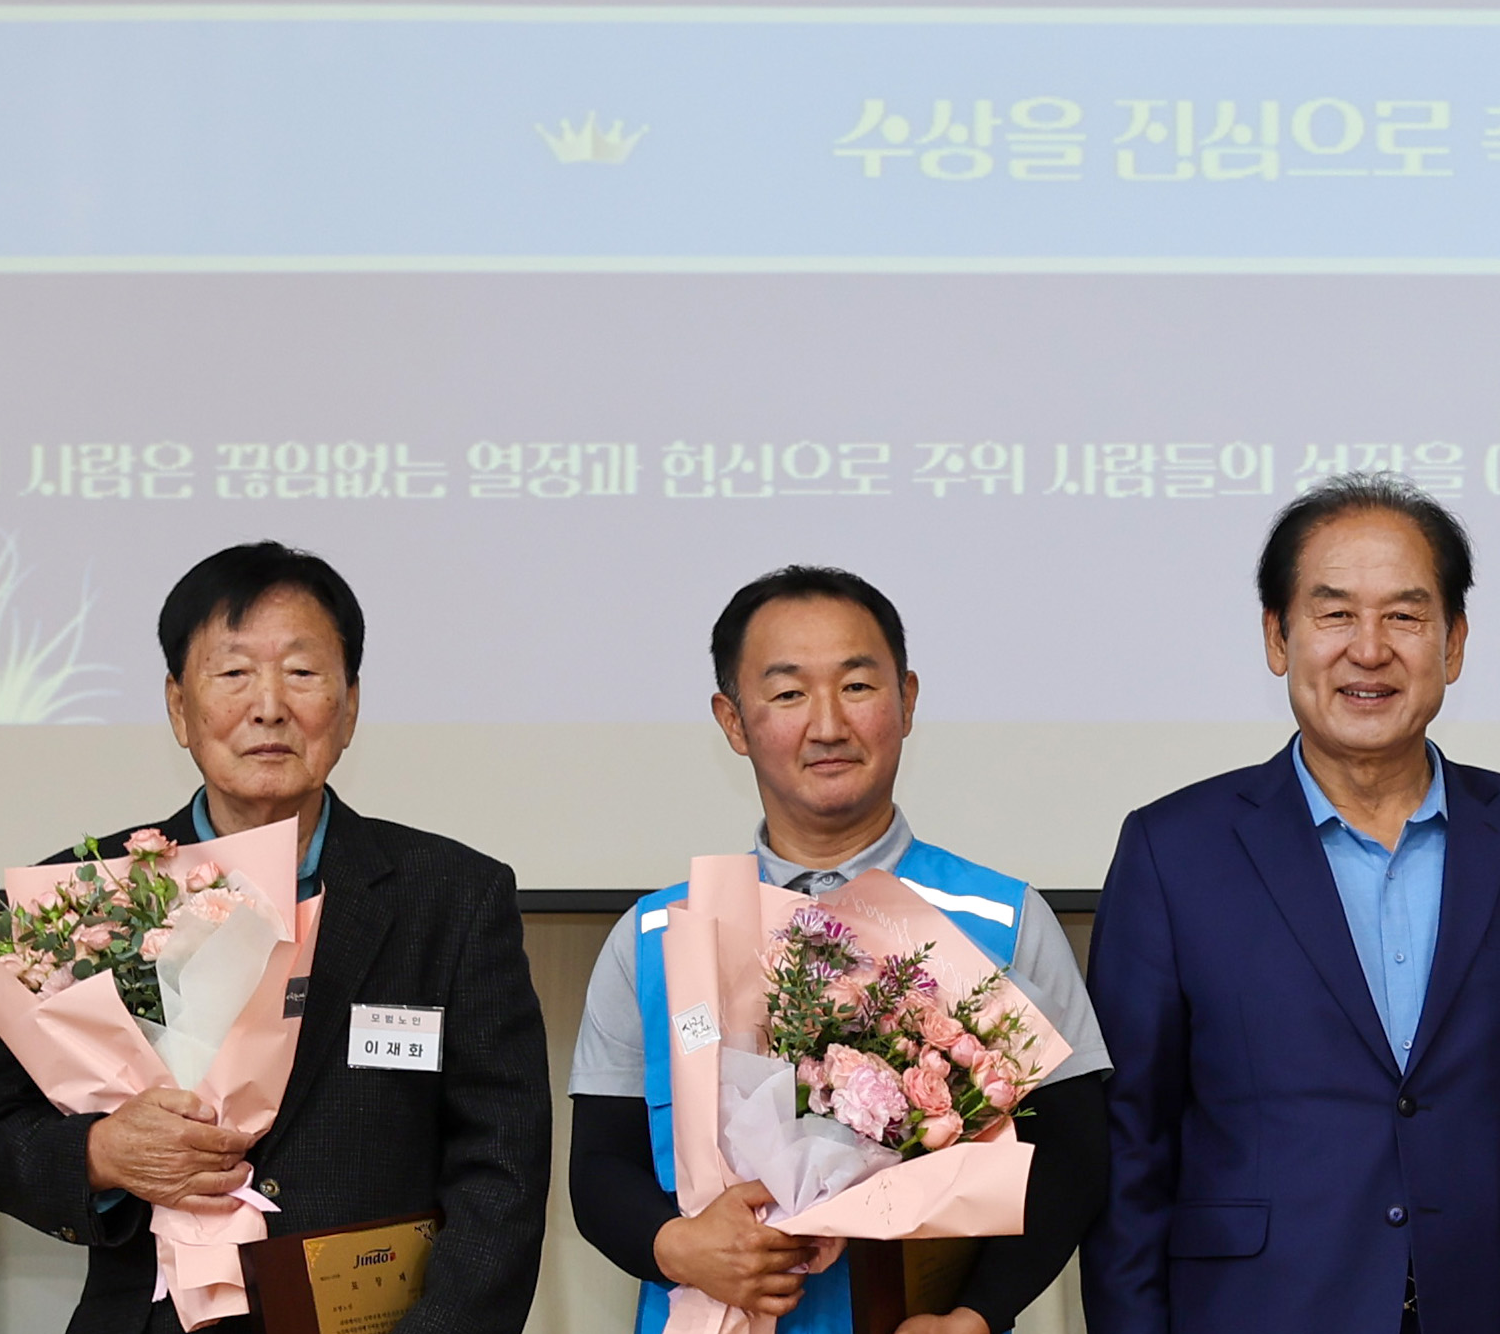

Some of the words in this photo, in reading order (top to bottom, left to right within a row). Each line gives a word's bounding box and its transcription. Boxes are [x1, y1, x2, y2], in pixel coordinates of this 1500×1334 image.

[834, 96, 1086, 180] 수상을
[1115, 98, 1452, 180] 진심으로
[18, 440, 195, 499] 사람은
[214, 441, 449, 500] 끊임없는
[466, 441, 642, 498] 열정과
[661, 441, 891, 498] 헌신으로
[911, 443, 1026, 497] 주위
[1051, 443, 1274, 499] 사람들의
